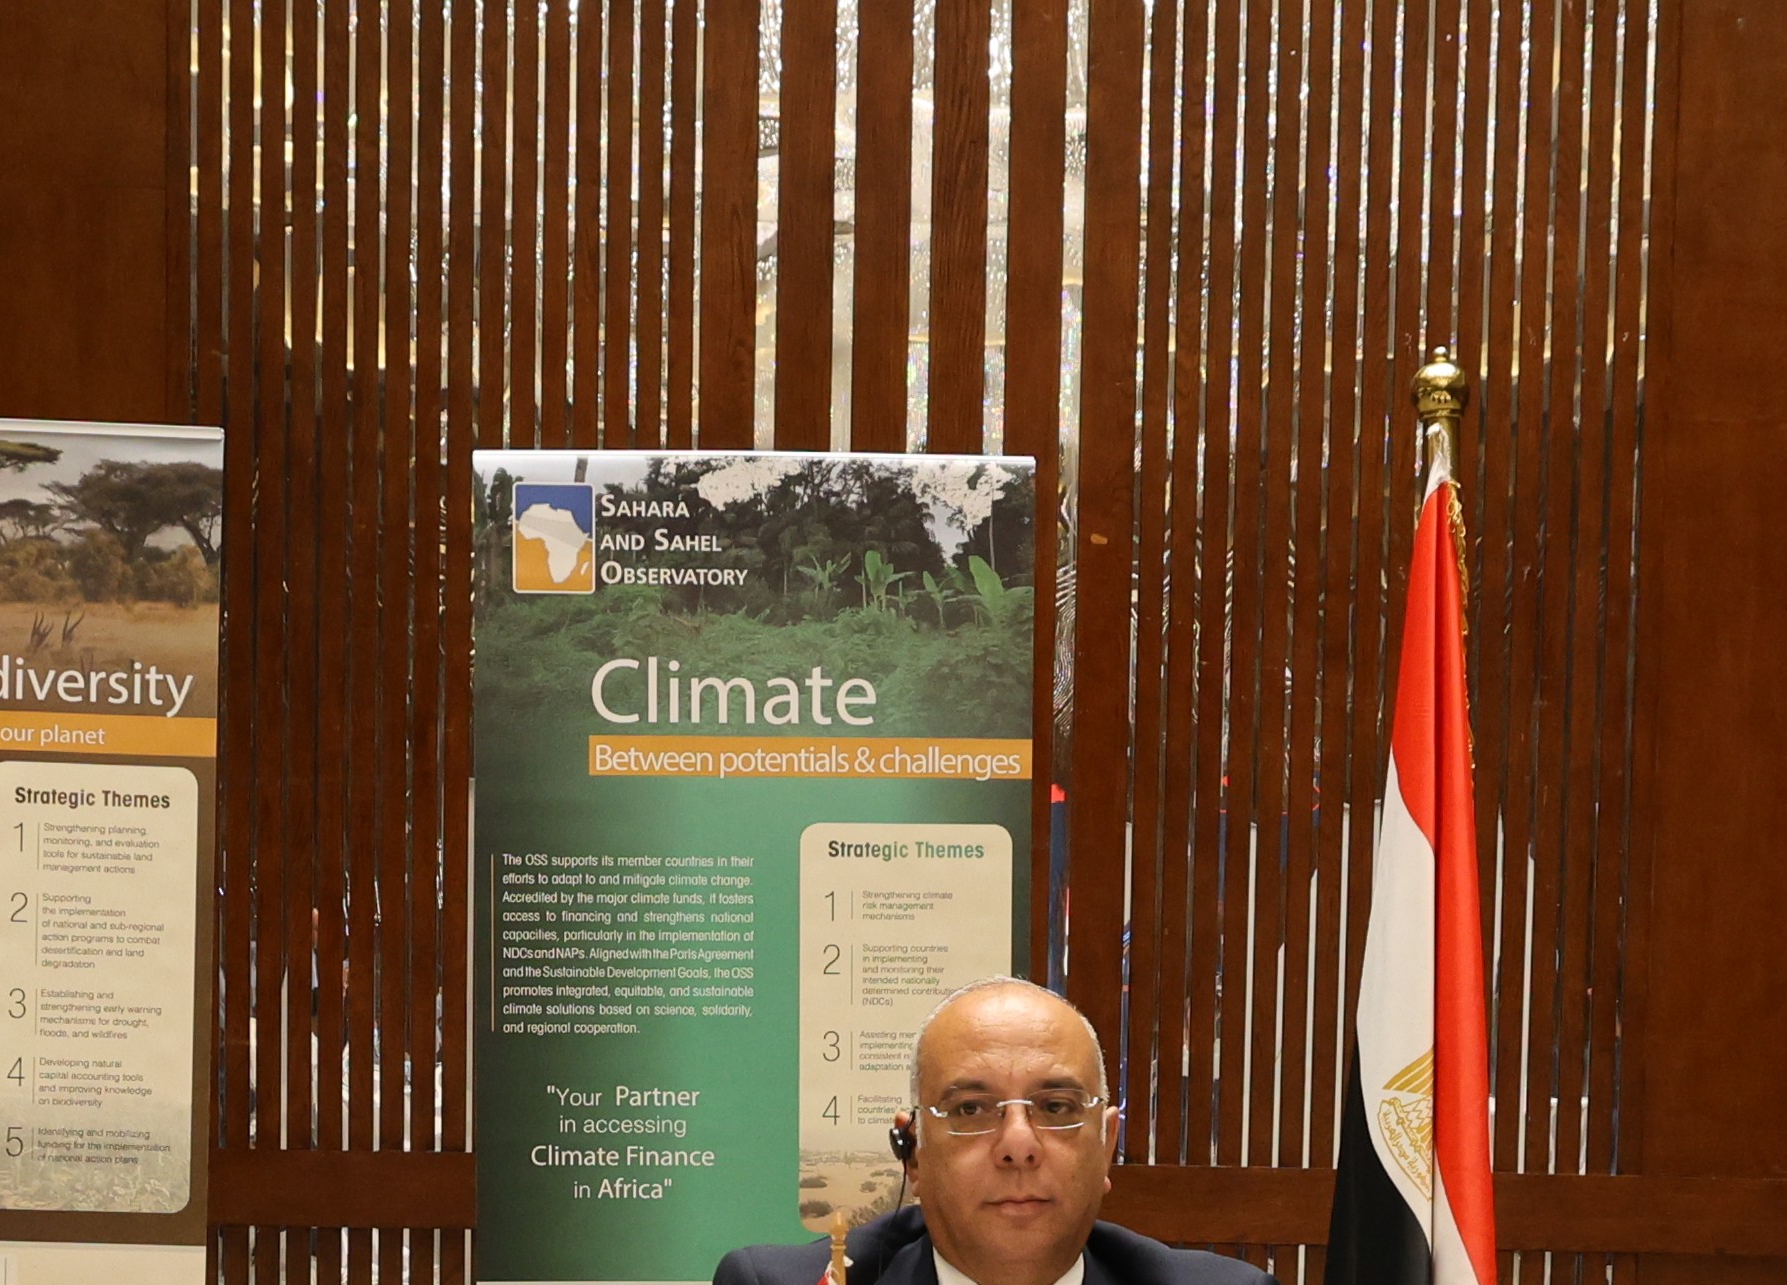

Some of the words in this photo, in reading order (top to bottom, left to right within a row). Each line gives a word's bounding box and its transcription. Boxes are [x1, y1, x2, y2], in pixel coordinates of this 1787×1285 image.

[590, 656, 878, 726] Climate
[0, 727, 35, 741] our
[40, 724, 105, 746] planet
[595, 744, 713, 773] Between
[719, 745, 850, 778] potentials
[854, 746, 875, 772] &
[879, 746, 1021, 781] challenges
[14, 786, 95, 808] Strategic
[101, 790, 170, 808] Themes
[14, 822, 23, 852] 1
[828, 840, 908, 861] Strategic
[915, 841, 984, 858] Themes
[501, 852, 522, 865] The
[524, 853, 548, 866] OSS
[551, 855, 598, 868] supports
[601, 854, 614, 866] its
[617, 855, 661, 866] member
[665, 856, 713, 866] countries
[717, 856, 727, 866] in
[731, 856, 753, 866] their
[10, 891, 28, 922] 2
[824, 890, 834, 921] 1
[823, 944, 840, 974] 2
[8, 987, 26, 1018] 3
[822, 1030, 840, 1061] 3
[6, 1056, 25, 1086] 4
[616, 1085, 700, 1106] Partner
[821, 1095, 840, 1125] 4
[559, 1114, 576, 1133] in
[582, 1115, 686, 1137] accessing
[5, 1126, 23, 1157] 5
[530, 1144, 619, 1166] Climate
[626, 1145, 714, 1165] Finance
[573, 1180, 590, 1198] in
